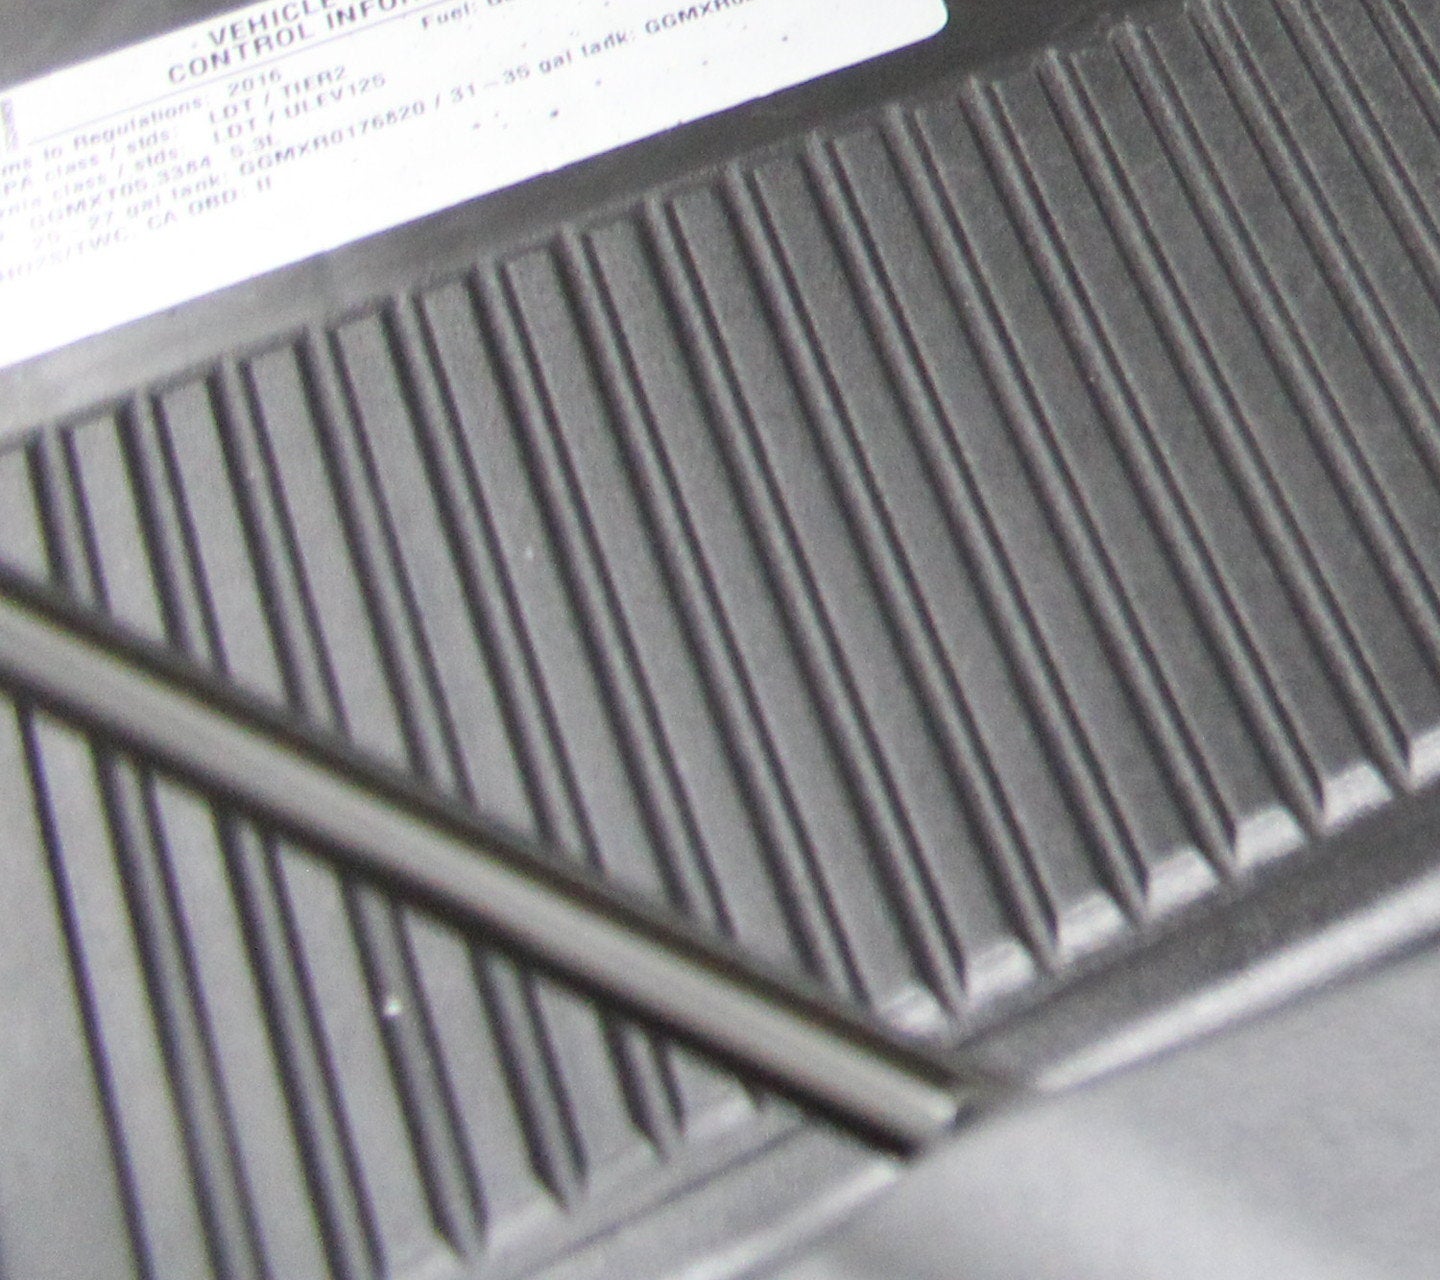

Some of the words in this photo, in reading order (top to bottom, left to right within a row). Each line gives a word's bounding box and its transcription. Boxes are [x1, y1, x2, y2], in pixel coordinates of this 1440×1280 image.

[420, 0, 478, 31] Fuel:
[167, 18, 315, 86] CONTROL
[448, 80, 477, 105] 31
[500, 61, 532, 86] 35
[535, 47, 574, 76] gal
[208, 97, 251, 125] LDT
[282, 64, 348, 99] TIER2
[213, 116, 256, 144] LDT
[283, 70, 388, 120] ULEV125
[227, 66, 282, 98] 2016
